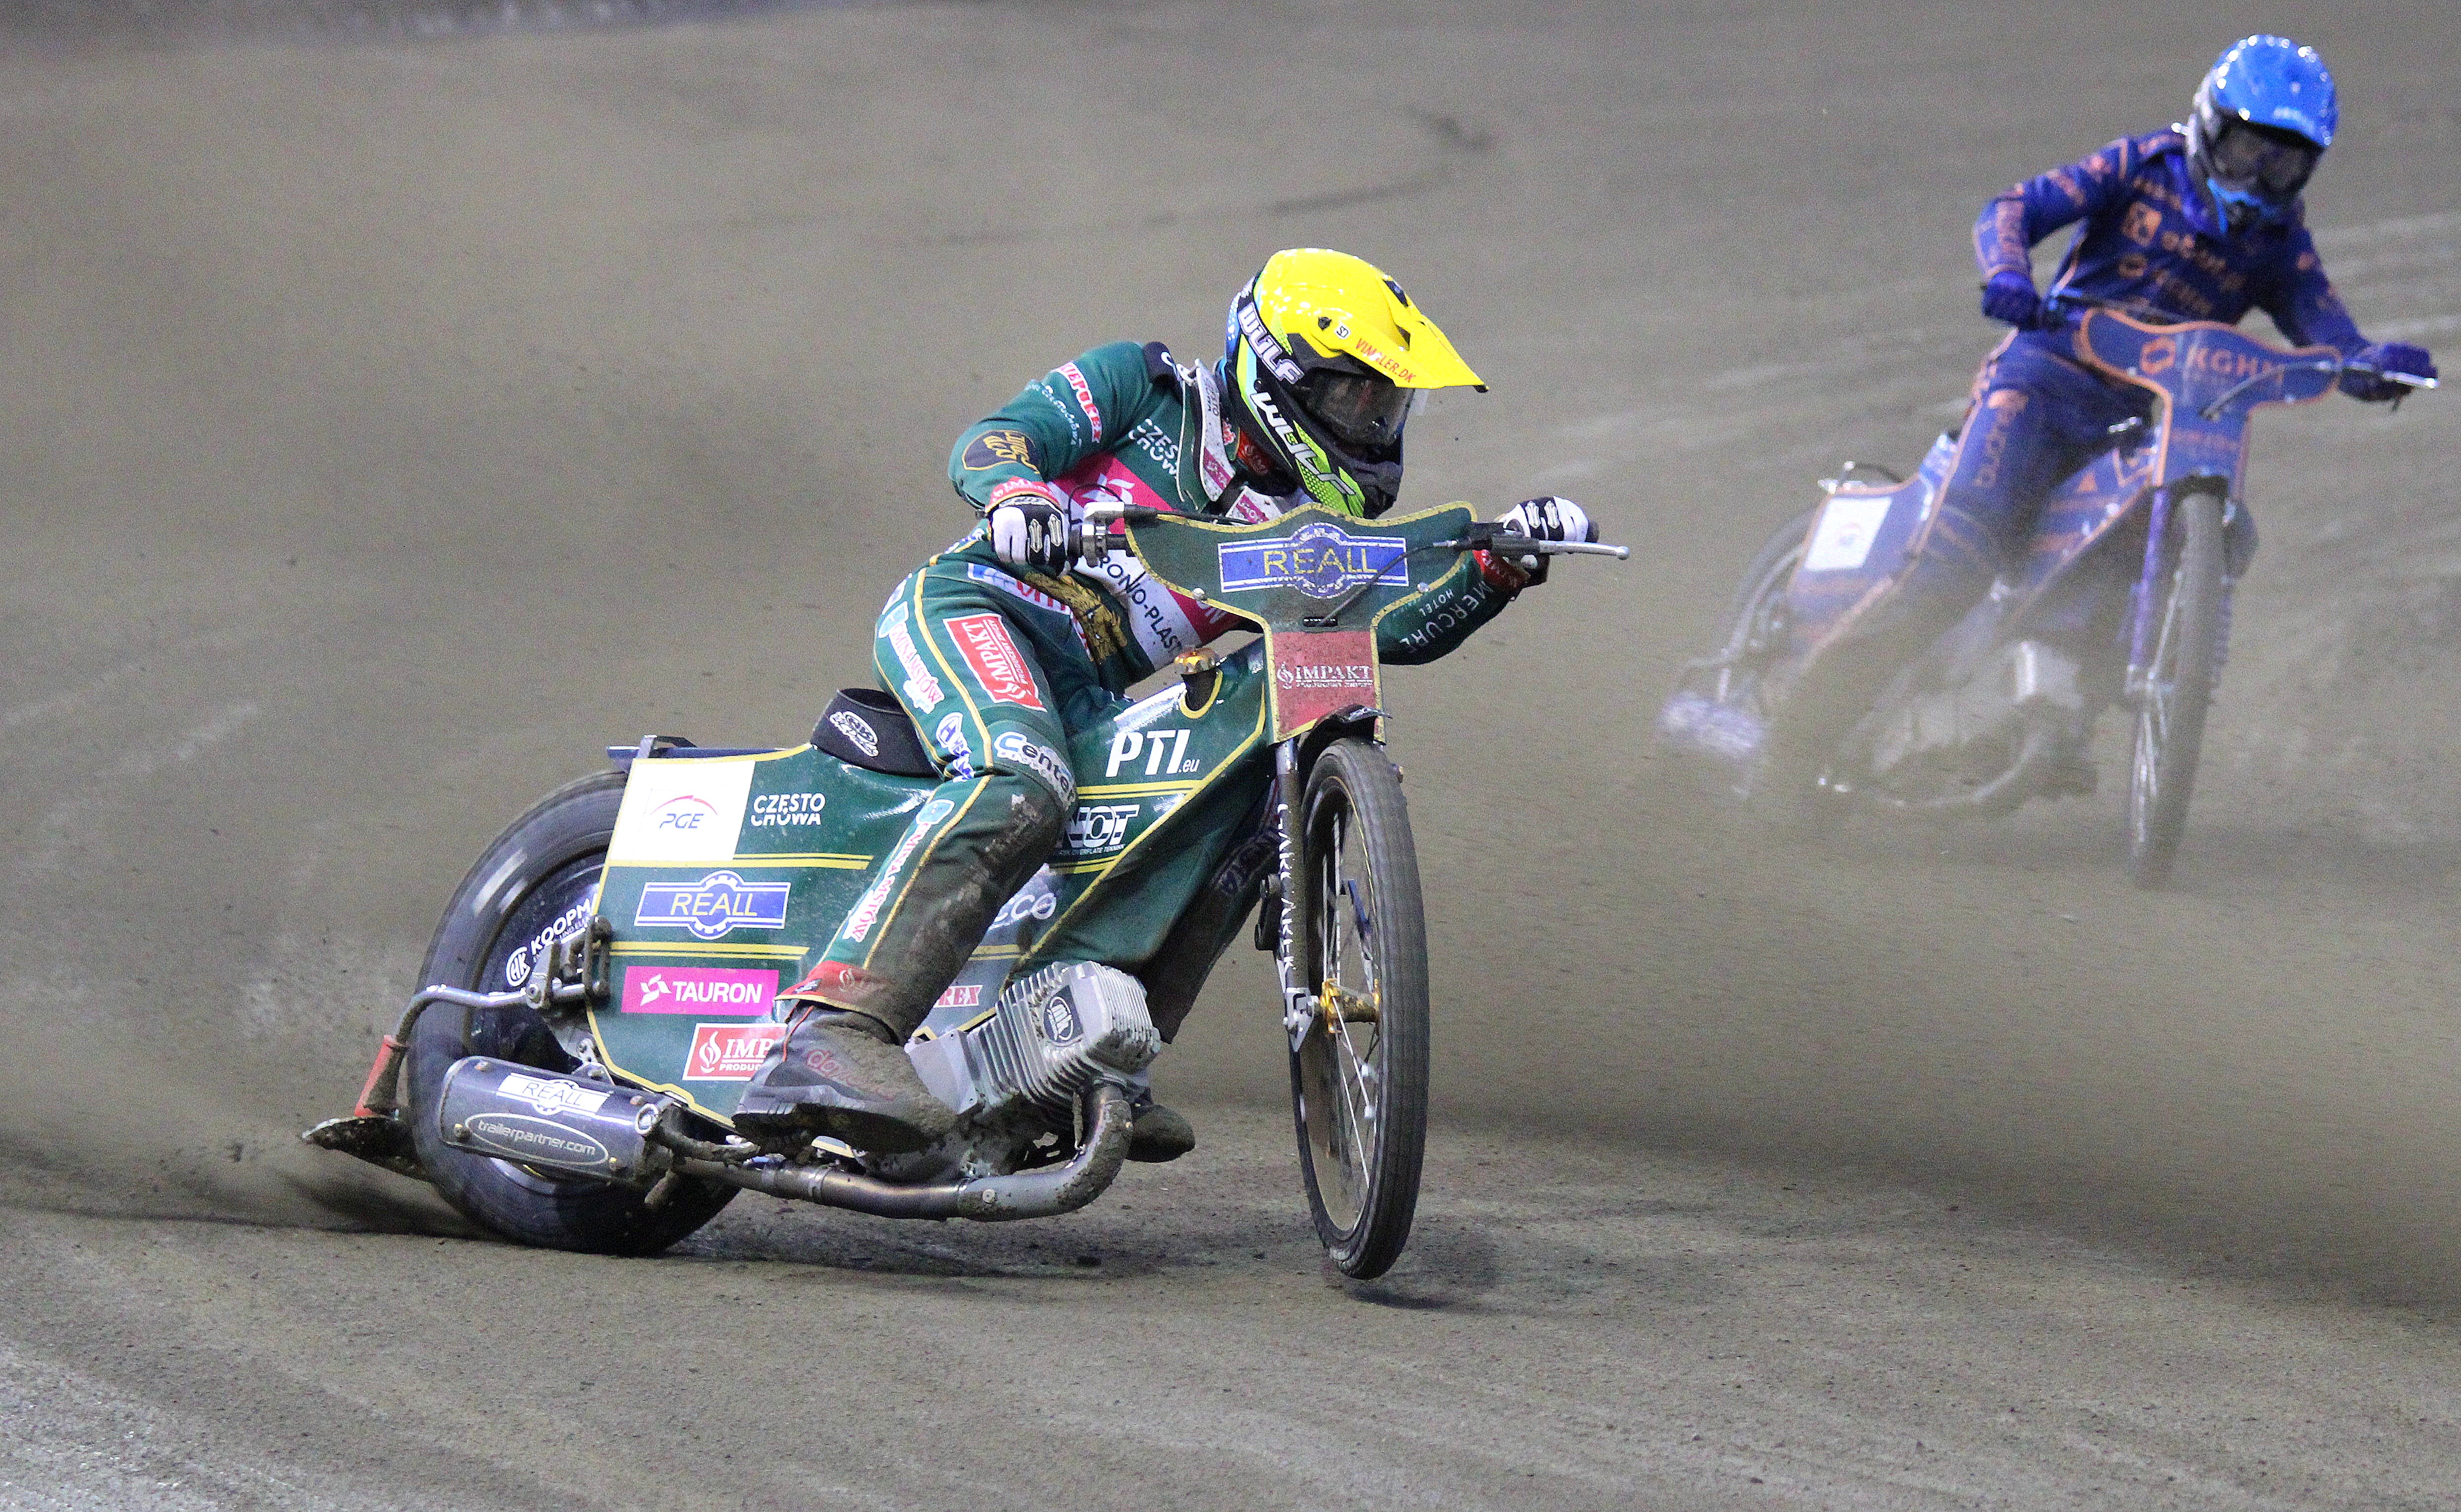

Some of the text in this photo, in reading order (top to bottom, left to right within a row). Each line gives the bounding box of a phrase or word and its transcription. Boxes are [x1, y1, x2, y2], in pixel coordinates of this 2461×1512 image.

[1238, 303, 1304, 384] WULF
[1129, 429, 1179, 478] CHOW
[1263, 548, 1377, 576] REALL
[1418, 588, 1453, 617] HOTEL
[1399, 581, 1493, 653] MERCURE
[962, 621, 1014, 683] IMPAKT
[1295, 665, 1371, 679] IMPAKT
[660, 813, 704, 829] PGE
[750, 813, 821, 827] CHOWA
[670, 892, 758, 916] REALL
[672, 980, 762, 1003] TAURON
[522, 1082, 583, 1107] REALL
[478, 1119, 595, 1155] trailerpartner.com
